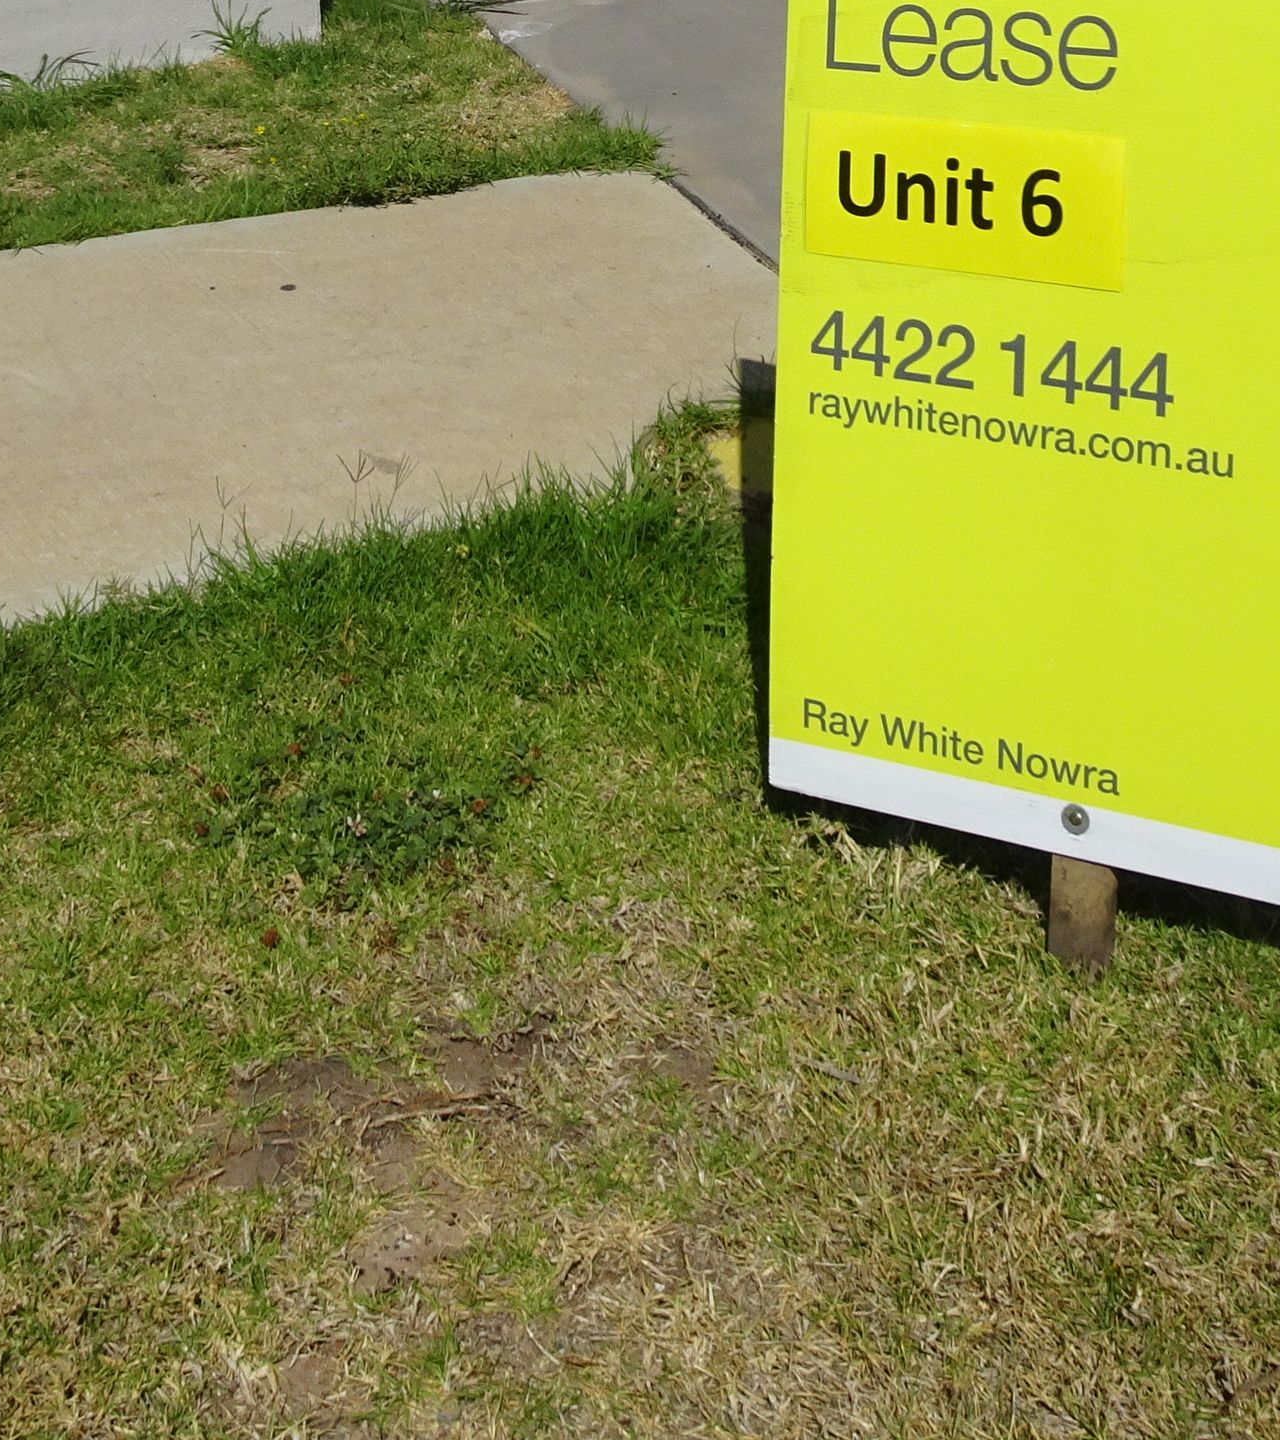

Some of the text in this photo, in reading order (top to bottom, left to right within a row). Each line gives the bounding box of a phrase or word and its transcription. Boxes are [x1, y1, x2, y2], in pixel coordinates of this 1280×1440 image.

[837, 149, 1064, 238] Unit 6
[809, 310, 1175, 418] 4422 1444
[808, 389, 1235, 479] raywhitenowra.com.au
[802, 697, 1120, 796] Ray White Nowra
